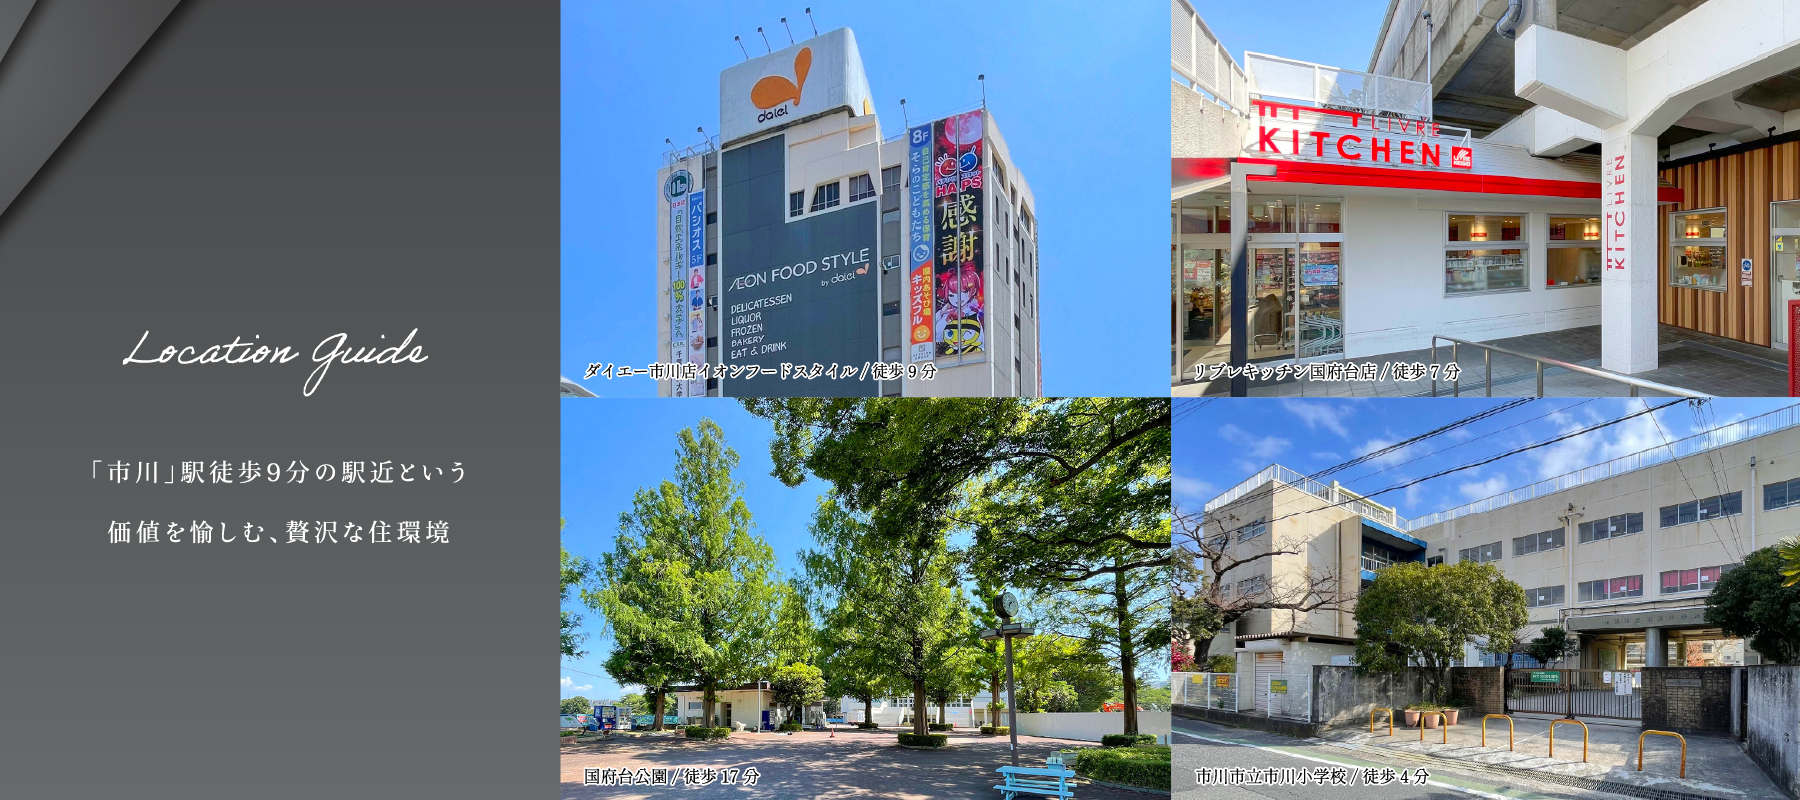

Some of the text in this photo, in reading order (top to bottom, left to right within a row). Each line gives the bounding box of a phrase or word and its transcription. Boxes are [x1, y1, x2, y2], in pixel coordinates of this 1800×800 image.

[912, 130, 929, 144] 8F
[1371, 115, 1440, 137] LIVRE
[1259, 125, 1440, 167] KITCHEN
[912, 152, 922, 242] そらのこどもたち
[935, 176, 982, 198] HAPS
[1614, 154, 1625, 270] KITCHEN
[691, 202, 703, 252] パシオス
[942, 194, 978, 266] 感謝
[691, 254, 702, 264] 5F
[771, 260, 818, 282] FOOD
[821, 248, 870, 271] STYLE
[821, 279, 830, 287] by
[731, 293, 792, 314] DELICATESSEN
[912, 274, 923, 326] キッズフル
[731, 312, 762, 326] LIQUOR
[731, 323, 763, 338] FROZEN
[731, 335, 765, 347] BAKERY
[731, 348, 748, 360] EAT
[761, 341, 787, 354] DRINK
